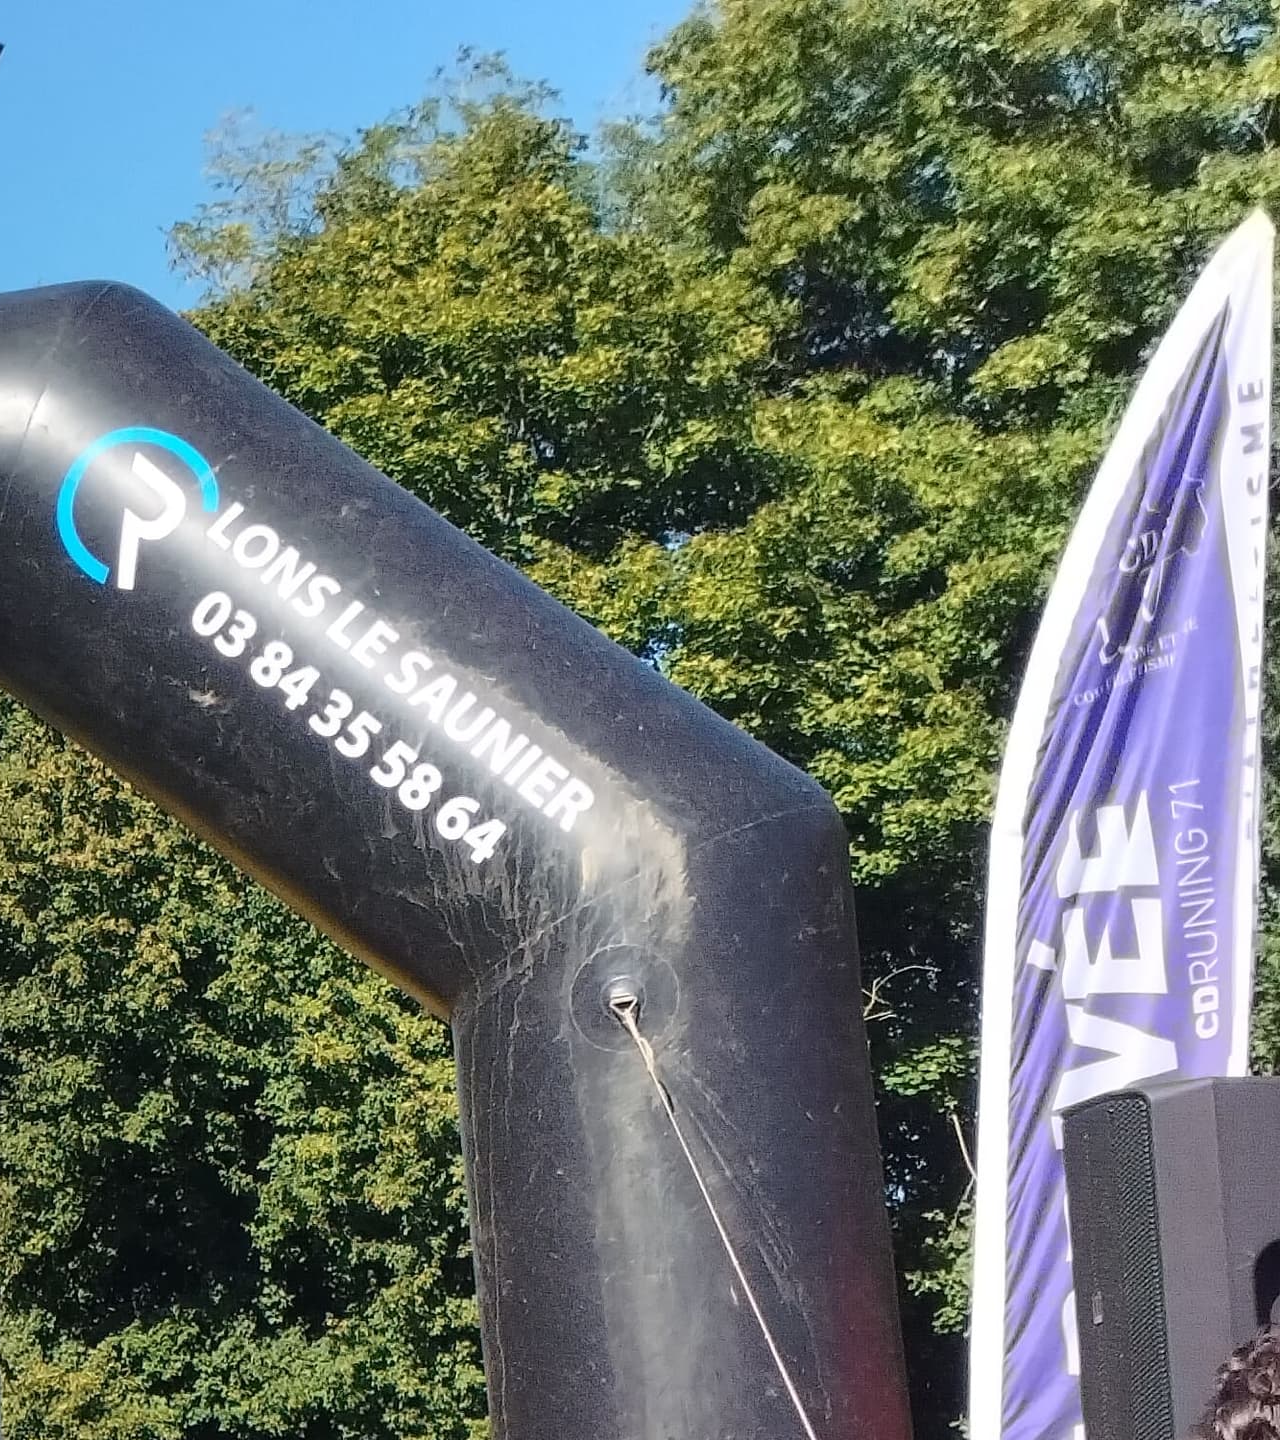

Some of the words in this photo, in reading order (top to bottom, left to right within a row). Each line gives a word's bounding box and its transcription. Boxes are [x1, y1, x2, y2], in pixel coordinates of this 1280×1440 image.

[191, 590, 258, 658] 03
[250, 639, 321, 711] 84
[308, 688, 383, 759] 35
[370, 740, 443, 810] 58
[436, 796, 507, 864] 64
[205, 502, 340, 619] LONS
[325, 600, 399, 668] LE
[384, 645, 595, 833] SAUNIER
[1166, 777, 1205, 820] 71
[1173, 828, 1219, 1039] CDRUNING
